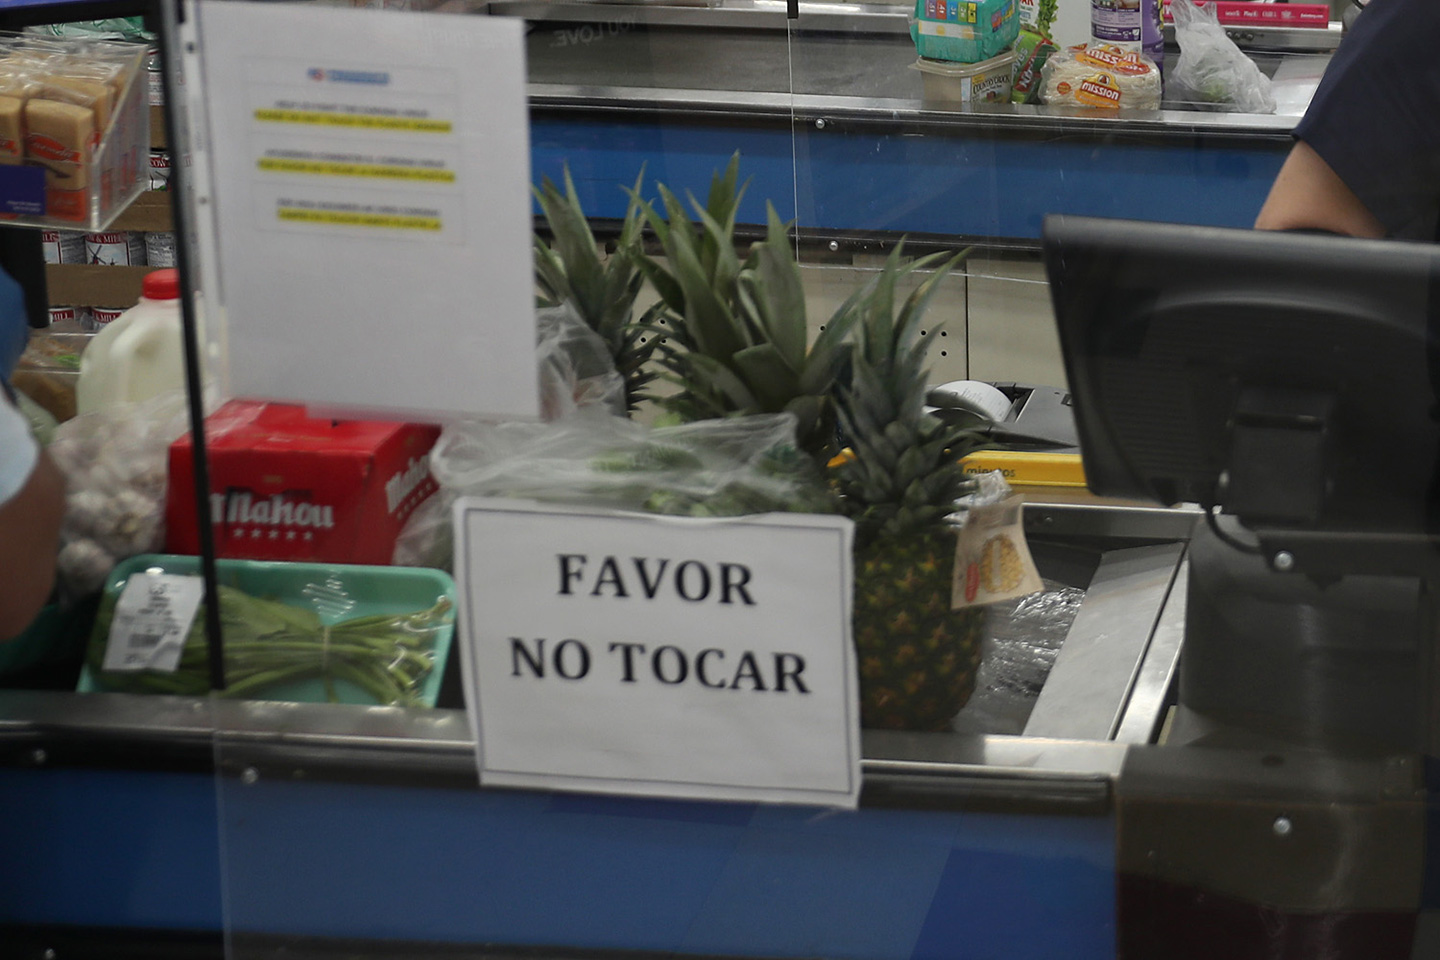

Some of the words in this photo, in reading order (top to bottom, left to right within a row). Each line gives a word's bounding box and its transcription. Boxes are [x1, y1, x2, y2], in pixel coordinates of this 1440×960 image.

[210, 491, 336, 528] Mahou
[556, 553, 757, 606] FAVOR
[507, 636, 592, 681] NO
[607, 641, 812, 695] TOCAR
